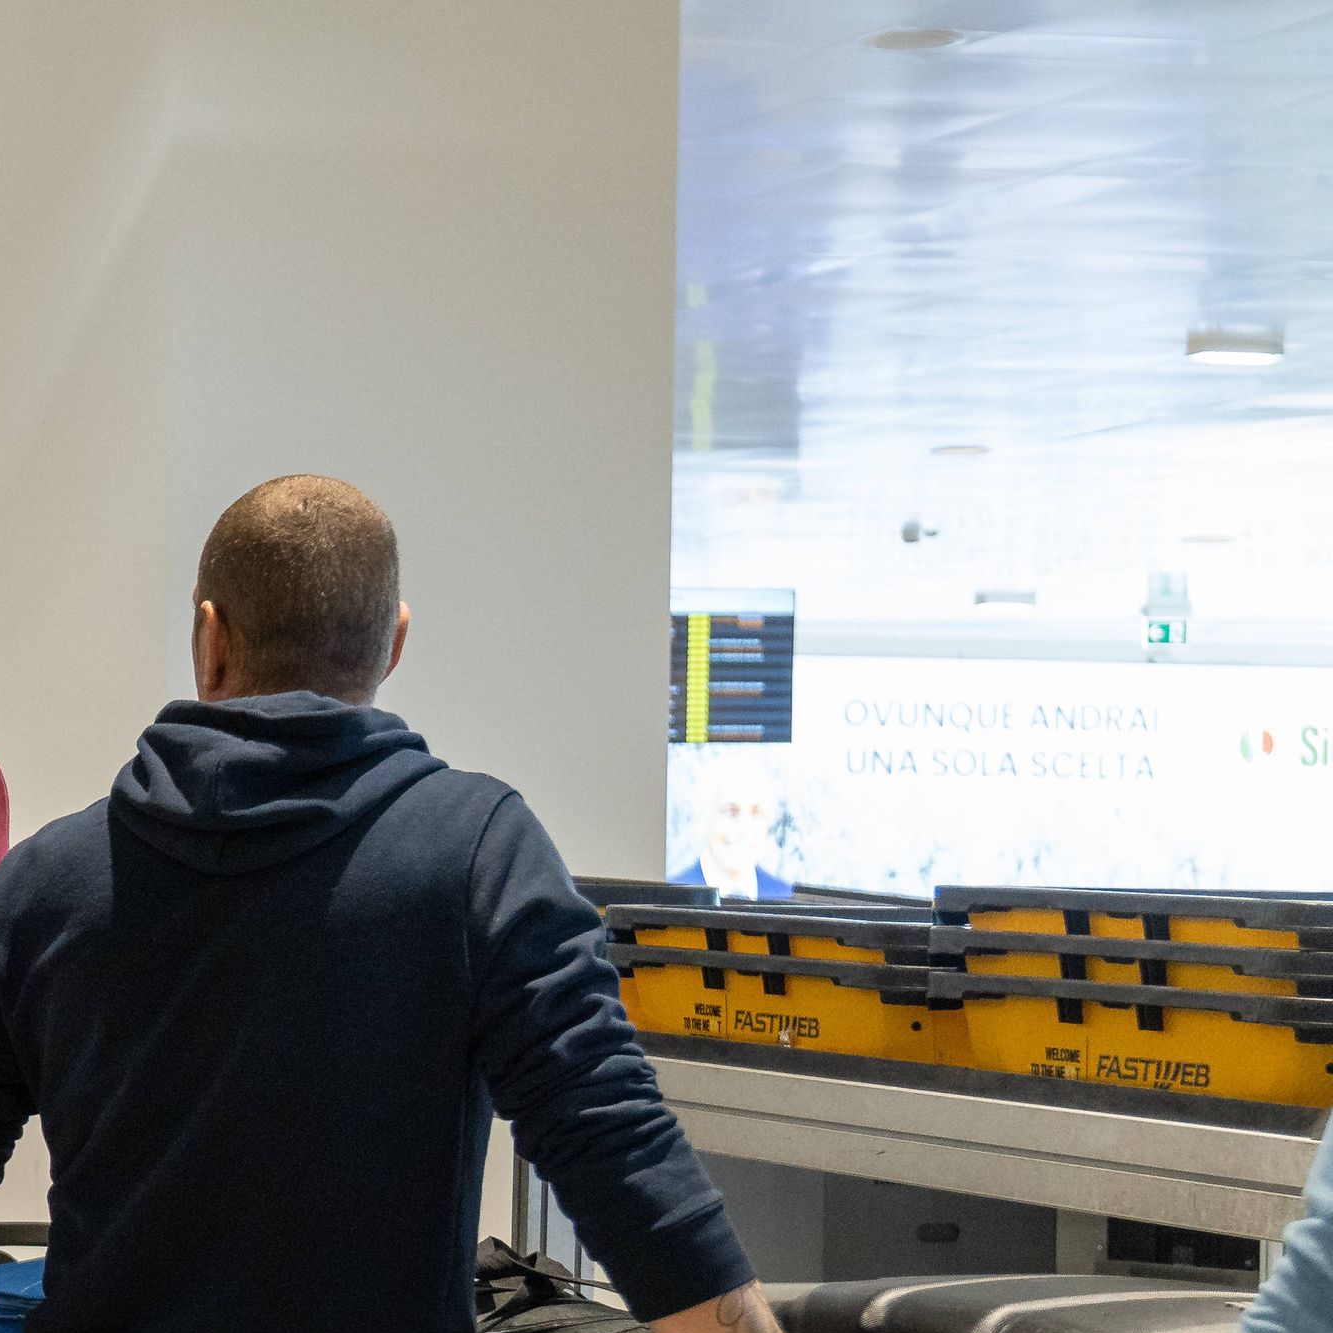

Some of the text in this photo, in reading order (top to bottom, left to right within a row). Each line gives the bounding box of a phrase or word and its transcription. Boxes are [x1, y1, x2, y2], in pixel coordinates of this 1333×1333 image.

[844, 699, 1158, 732] OVUNQUE ANDRAI
[1300, 725, 1333, 766] Si
[846, 750, 1154, 779] UNA SOLA SCELTA
[694, 1002, 722, 1017] WELCOME
[1045, 1046, 1080, 1063] WELCOME
[1096, 1054, 1211, 1090] FASTWEB
